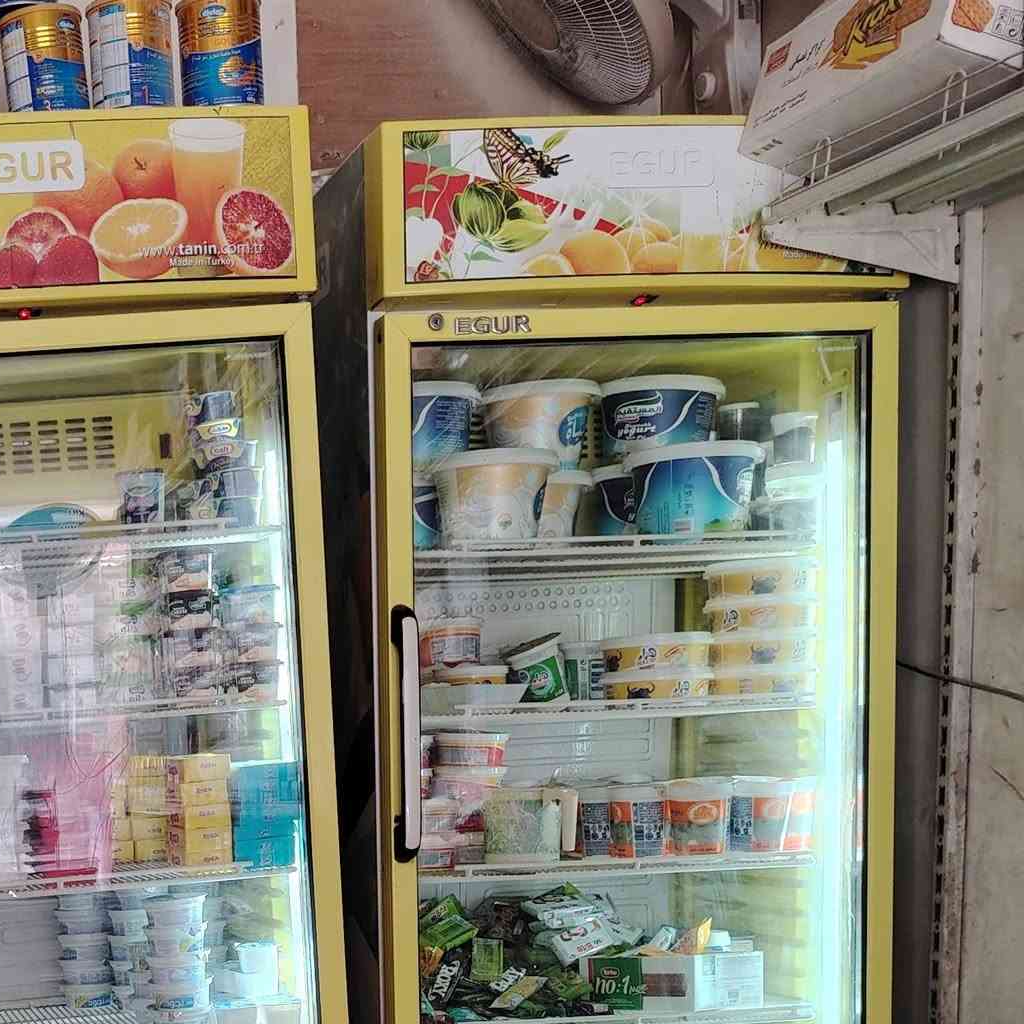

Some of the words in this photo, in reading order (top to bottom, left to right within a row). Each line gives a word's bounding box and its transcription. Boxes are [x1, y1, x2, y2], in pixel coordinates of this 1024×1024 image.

[609, 148, 703, 176] EGUR
[170, 257, 193, 267] Made
[206, 256, 236, 267] Turkey
[454, 314, 532, 335] EGUR
